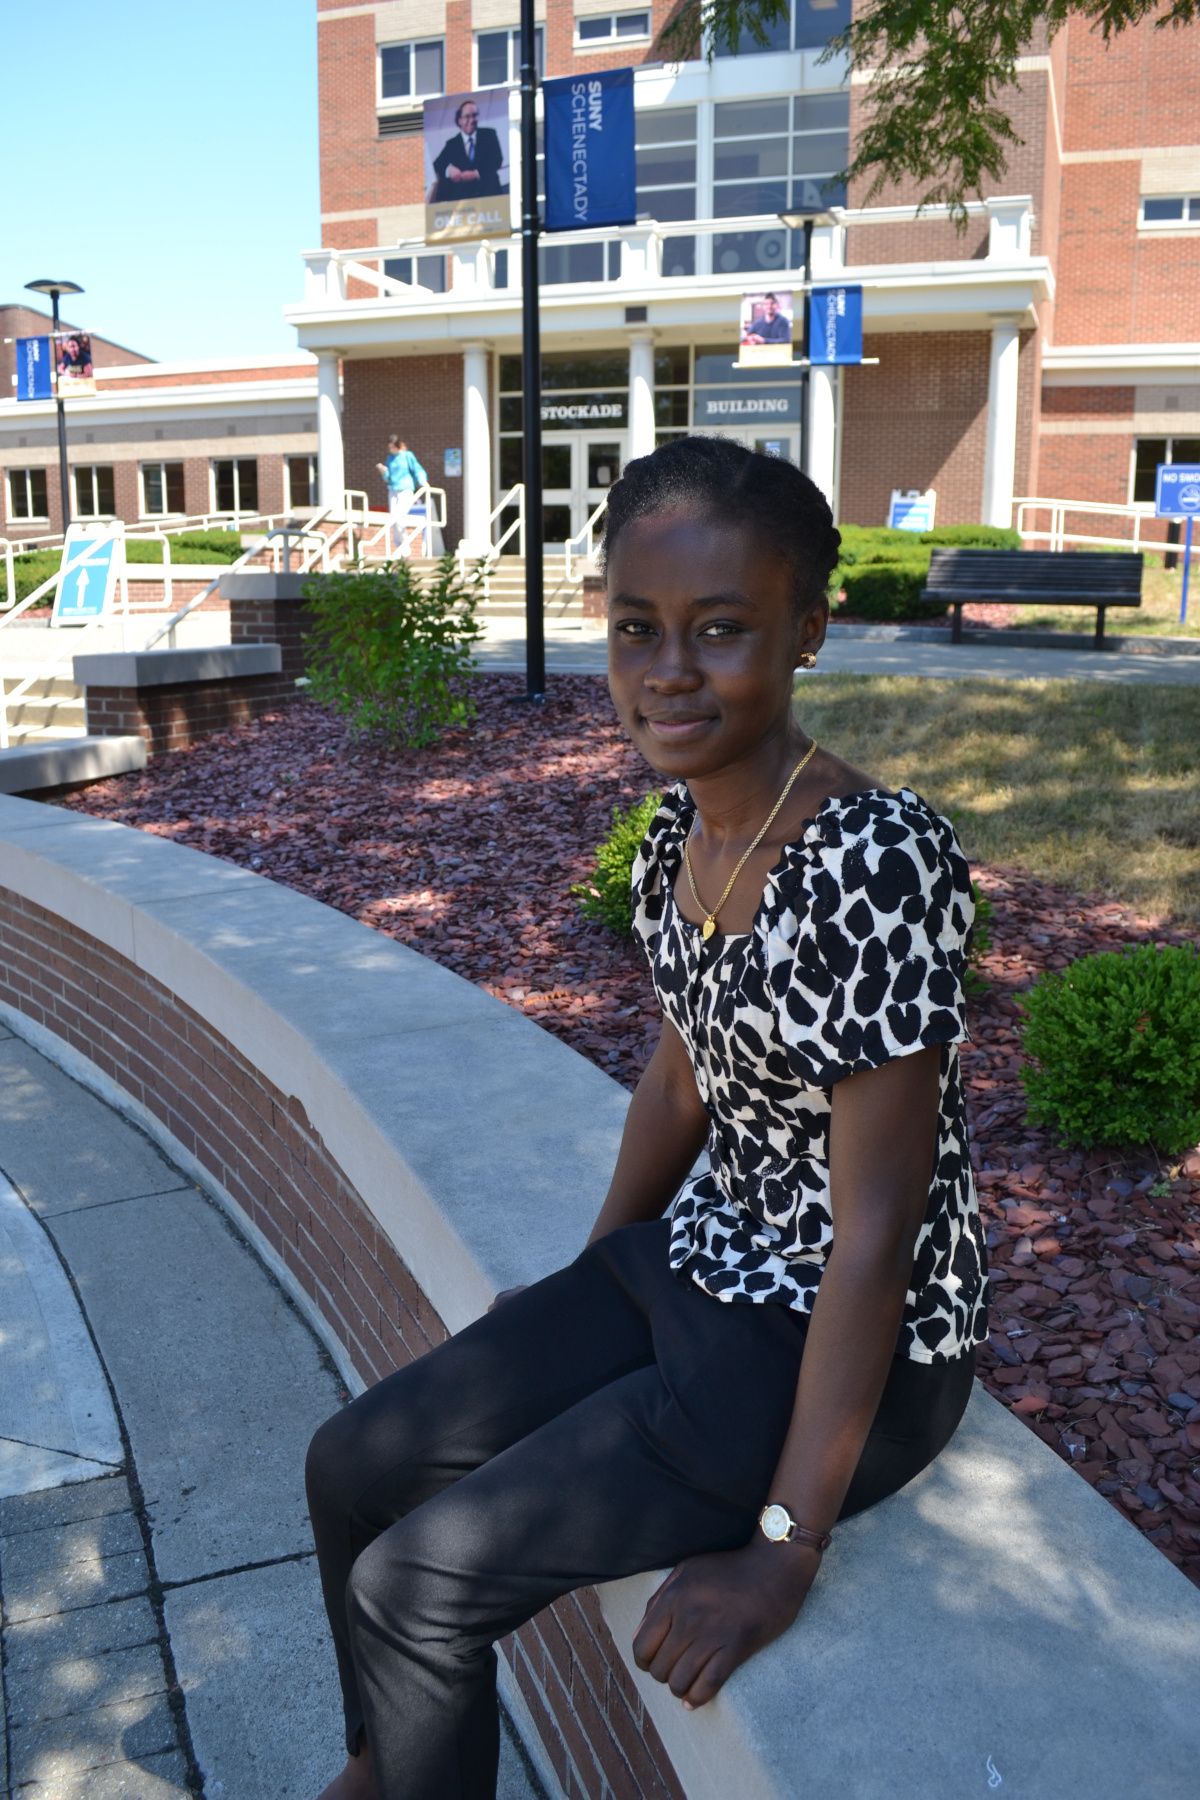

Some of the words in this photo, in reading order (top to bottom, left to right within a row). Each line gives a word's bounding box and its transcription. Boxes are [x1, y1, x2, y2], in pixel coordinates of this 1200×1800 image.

[588, 80, 603, 131] SUNY
[571, 83, 588, 221] SCHENECTADY
[434, 214, 464, 229] ONE
[466, 210, 503, 226] CALL
[540, 404, 623, 420] STOCKADE
[706, 399, 789, 415] BUILDING
[1163, 472, 1178, 484] NO
